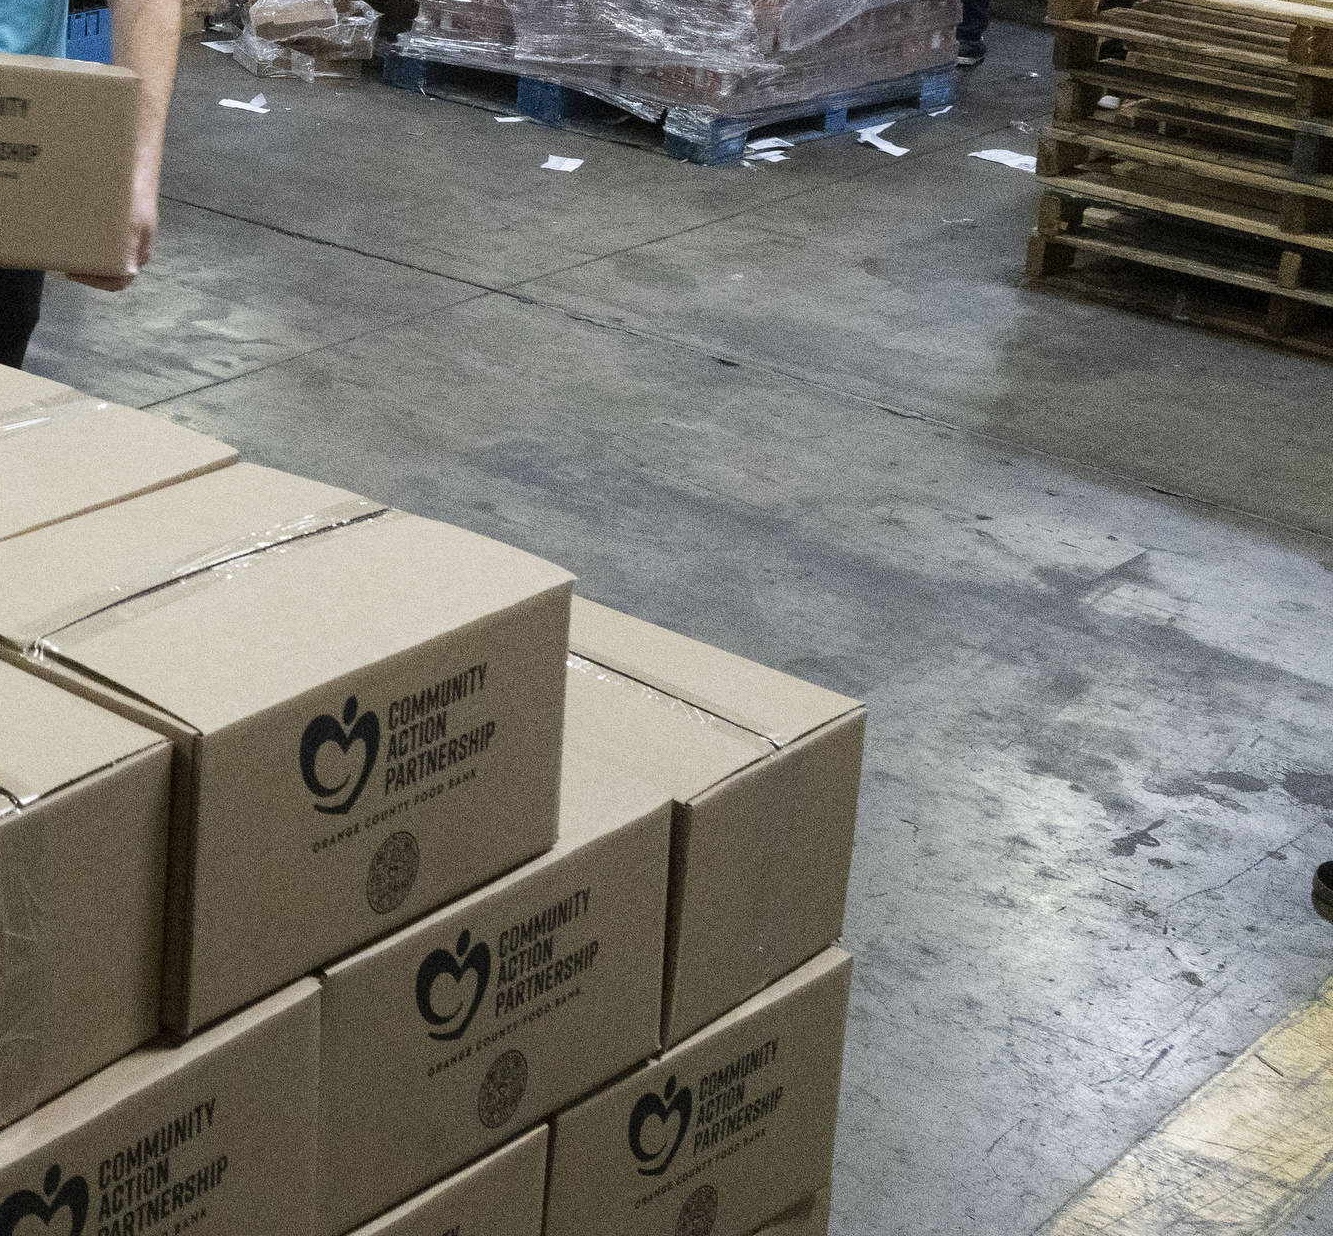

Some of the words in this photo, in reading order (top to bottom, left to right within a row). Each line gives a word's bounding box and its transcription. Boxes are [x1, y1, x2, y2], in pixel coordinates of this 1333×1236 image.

[388, 661, 487, 731] COMMUNITY
[384, 720, 496, 796] PARTNERSHIP
[386, 710, 447, 763] ACTION
[312, 823, 360, 854] ORANGE
[364, 799, 411, 830] COUNTY
[414, 782, 444, 807] FOOD
[448, 768, 477, 791] BANK
[498, 885, 591, 959] COMMUNITY
[495, 939, 600, 1018] PARTNERSHIP
[497, 936, 555, 989] ACTION
[699, 1037, 780, 1102] COMMUNITY
[693, 1086, 784, 1157] PARTNERSHIP
[696, 1082, 745, 1128] ACTION
[98, 1098, 216, 1190] COMMUNITY
[99, 1157, 169, 1222] ACTION
